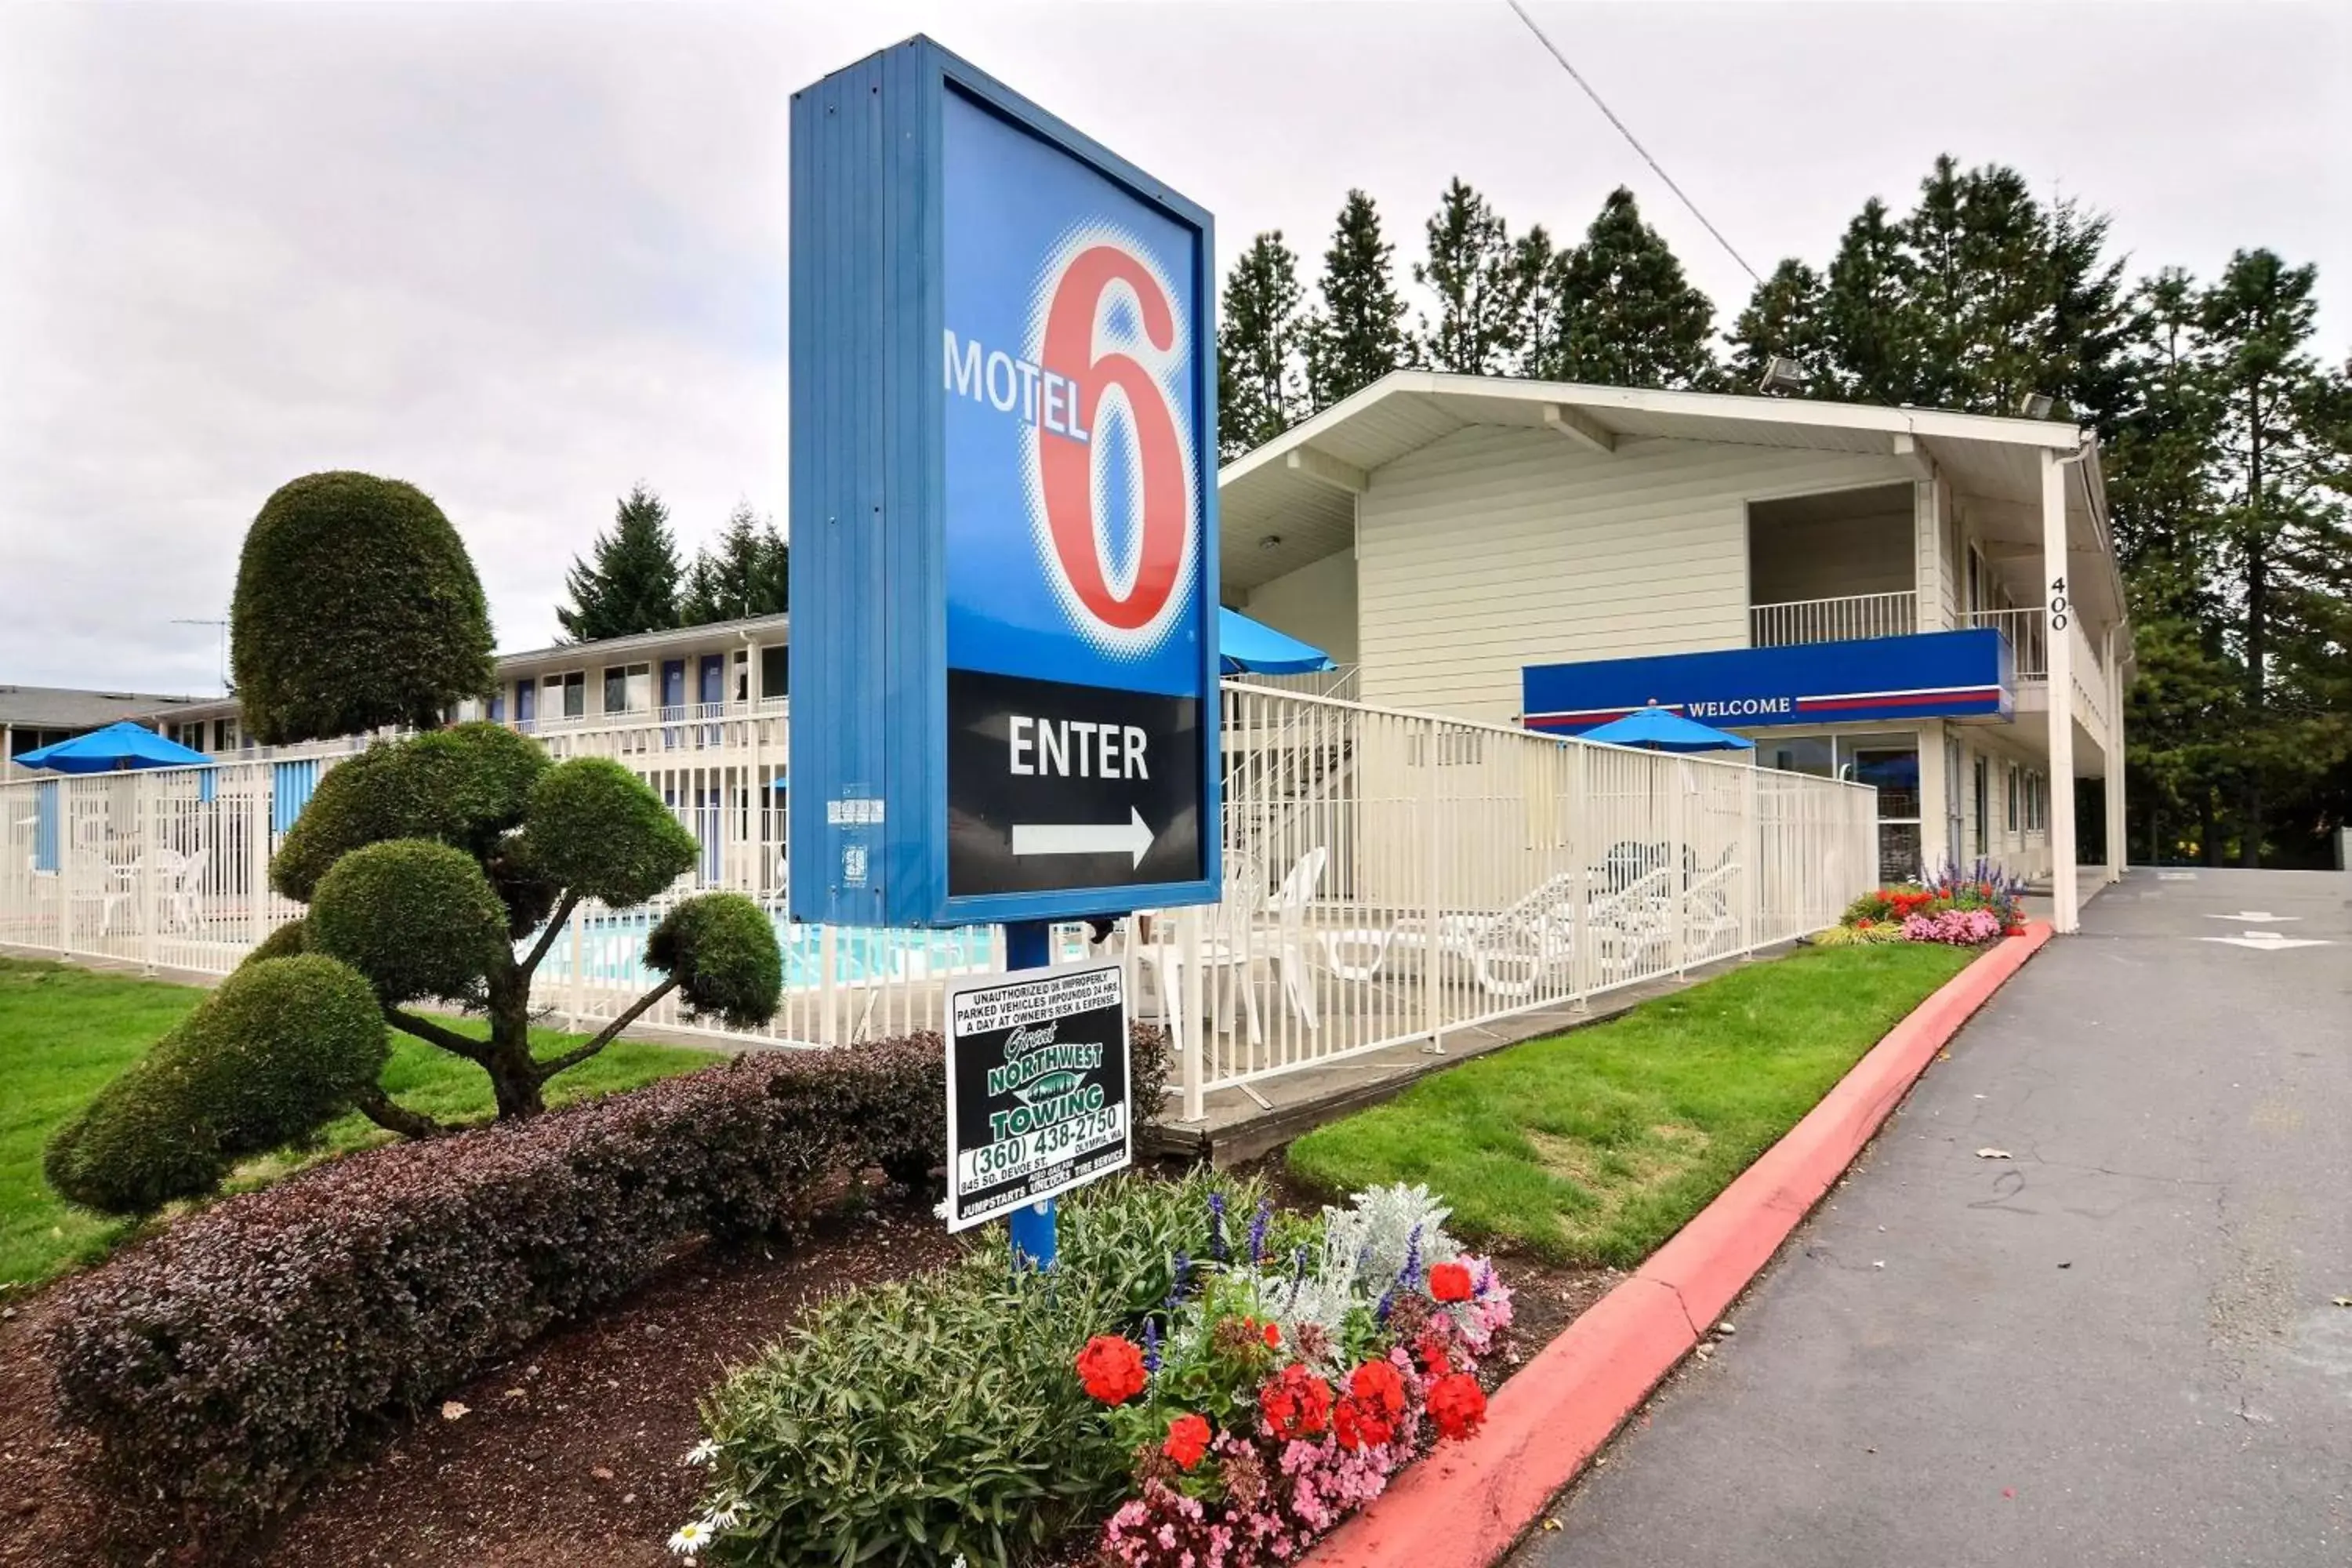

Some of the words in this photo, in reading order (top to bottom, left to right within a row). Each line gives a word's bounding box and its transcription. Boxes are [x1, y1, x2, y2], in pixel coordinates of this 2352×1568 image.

[944, 328, 1087, 441] MOTEL
[1039, 245, 1187, 630] 6
[2051, 576, 2067, 630] 400
[1688, 697, 1791, 717] WELCOME
[1010, 715, 1149, 779] ENTER
[957, 1004, 997, 1022] PARKED
[1000, 996, 1046, 1014] VEHICLES
[1048, 987, 1091, 1006] IMPOUNDED
[1093, 985, 1102, 996] 24
[1103, 982, 1117, 994] HRS
[967, 1022, 974, 1033] A
[976, 1018, 995, 1031] DAY
[998, 1015, 1010, 1027] AT
[1013, 1007, 1054, 1024] OWNER'S
[1055, 1004, 1073, 1015] RISK
[1083, 993, 1114, 1010] EXPENSE
[973, 984, 1049, 1005] UNAUTHORIZED
[1062, 972, 1108, 989] IMPROPERLY
[1004, 1021, 1058, 1061] Great
[988, 1043, 1103, 1097] NORTHWEST
[989, 1083, 1105, 1142] TOWING
[973, 1136, 1026, 1176] (360)
[1034, 1106, 1116, 1155] 438-2750
[960, 1178, 979, 1193] 845
[1001, 1161, 1031, 1180] DEVOE
[960, 1185, 1026, 1218] JUMPSTARTS
[1029, 1169, 1071, 1194] UNLOCKS
[1075, 1161, 1092, 1177] TIRE
[1094, 1149, 1124, 1169] SERVICE
